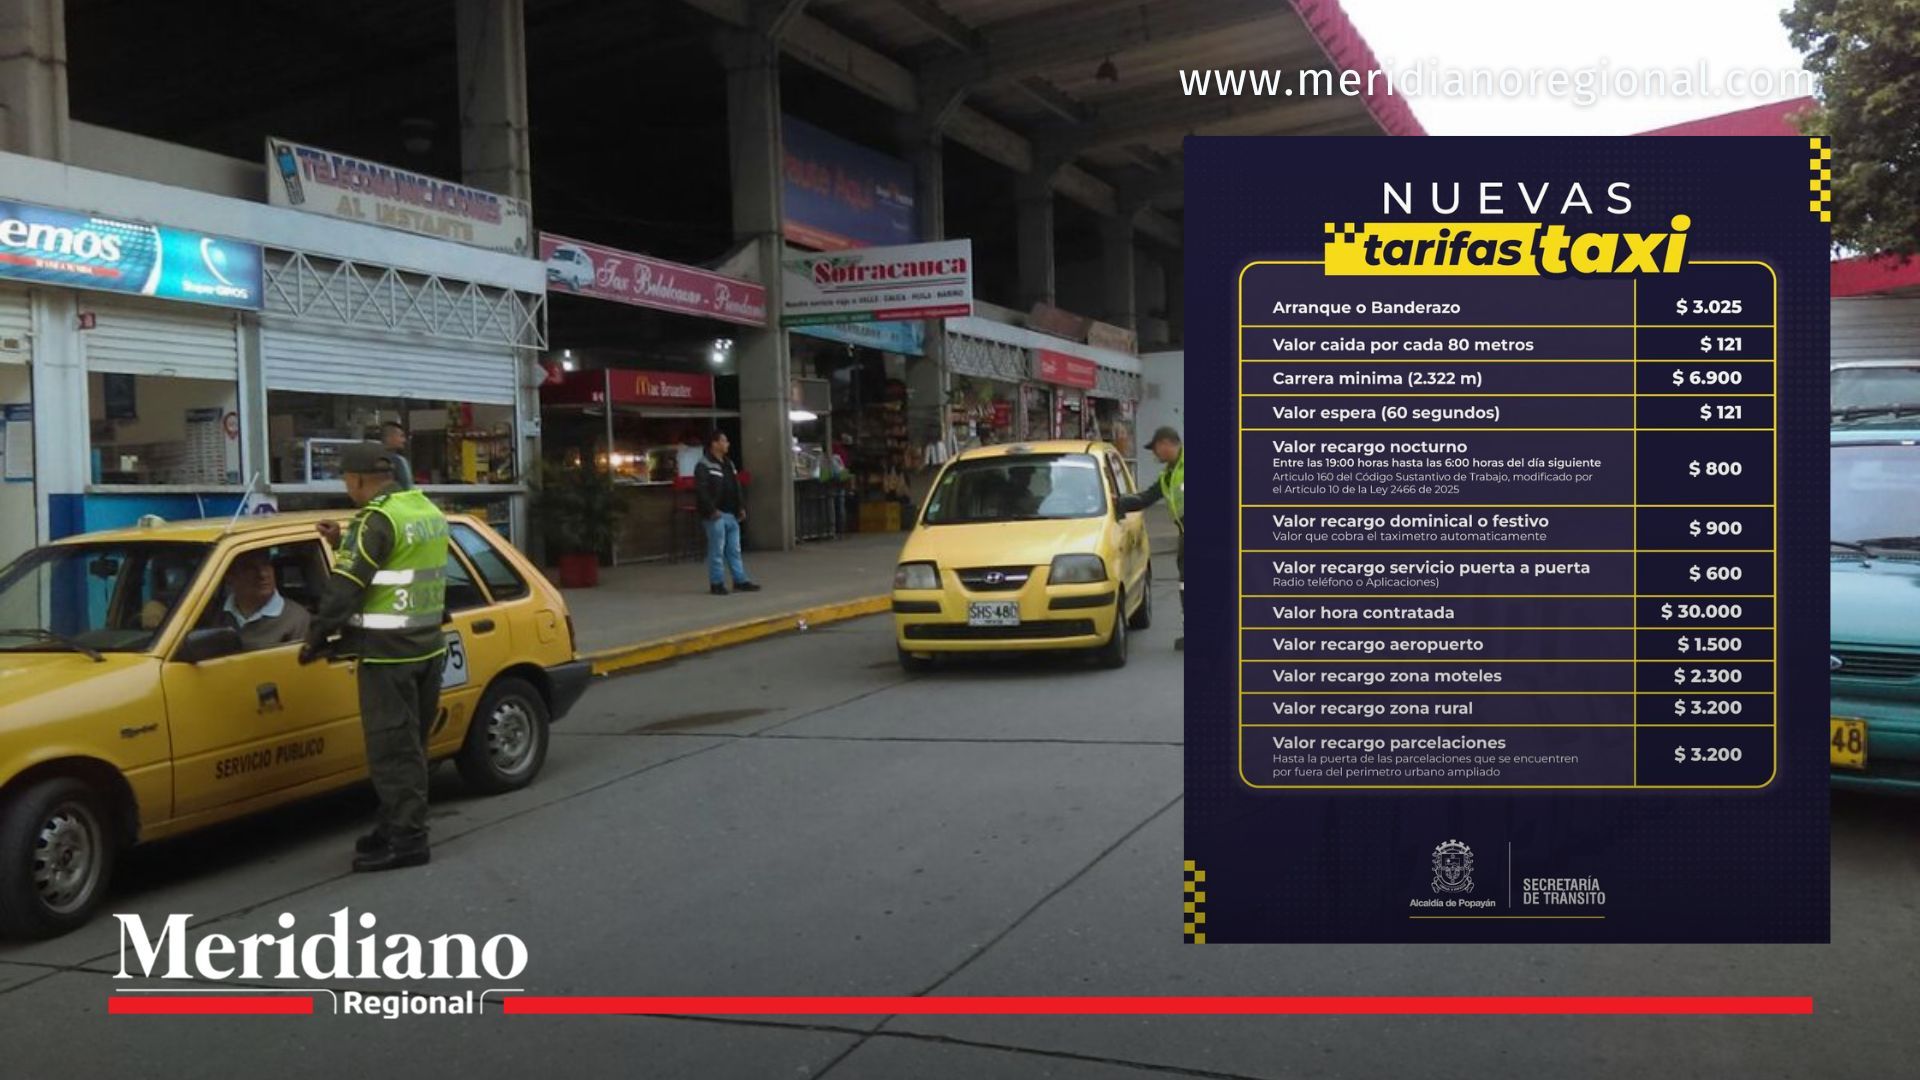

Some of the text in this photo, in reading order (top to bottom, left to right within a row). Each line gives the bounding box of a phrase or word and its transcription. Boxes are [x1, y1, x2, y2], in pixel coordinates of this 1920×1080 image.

[814, 257, 967, 284] Sotracauca
[215, 737, 325, 779] SERVICIO PUBLICO
